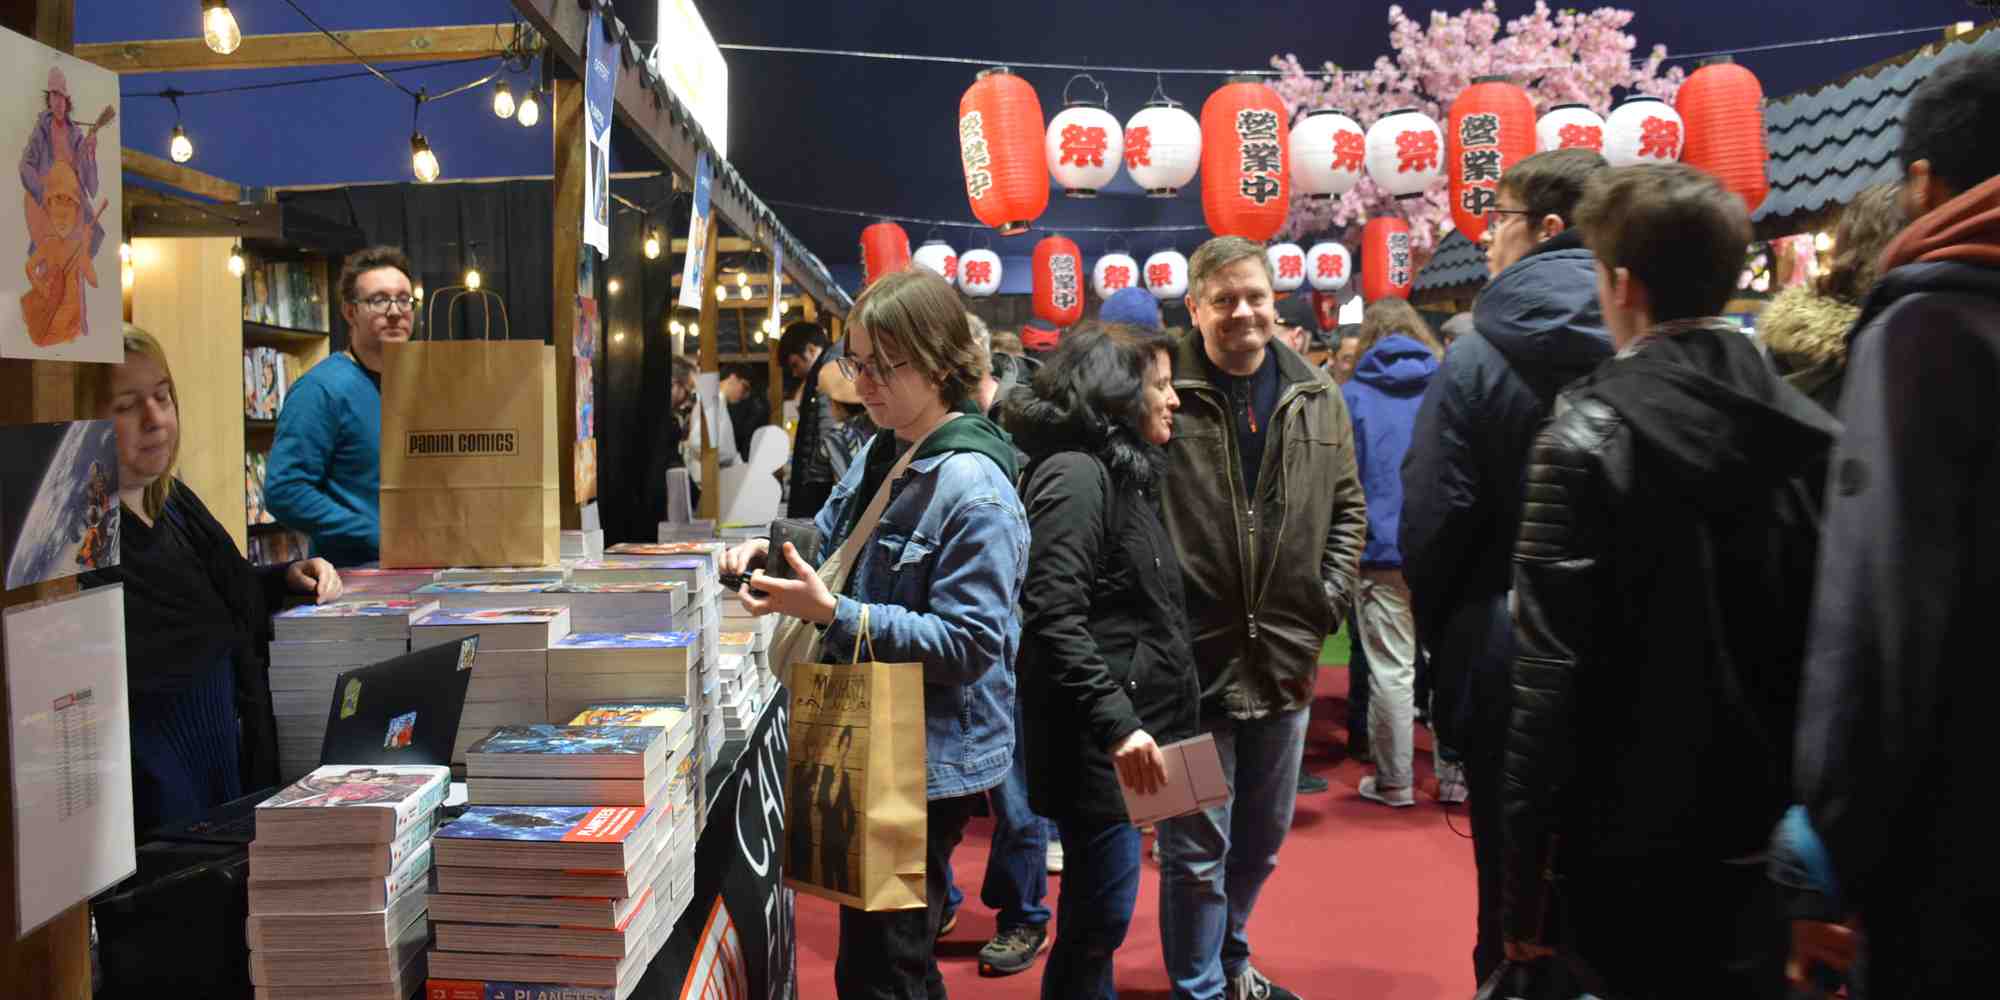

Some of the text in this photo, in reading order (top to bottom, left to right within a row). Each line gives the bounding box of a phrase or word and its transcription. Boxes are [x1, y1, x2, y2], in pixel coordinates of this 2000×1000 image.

[1060, 123, 1107, 168] 祭
[1638, 115, 1680, 159] 祭
[1236, 109, 1282, 206] 營業中
[1331, 128, 1366, 173] 祭
[1395, 129, 1438, 173] 祭
[965, 260, 992, 284] 祭
[1103, 264, 1131, 289] 祭
[1149, 262, 1173, 287] 祭
[1278, 254, 1303, 278] 祭
[1317, 253, 1343, 278] 祭
[408, 432, 514, 454] PANINI COMICS
